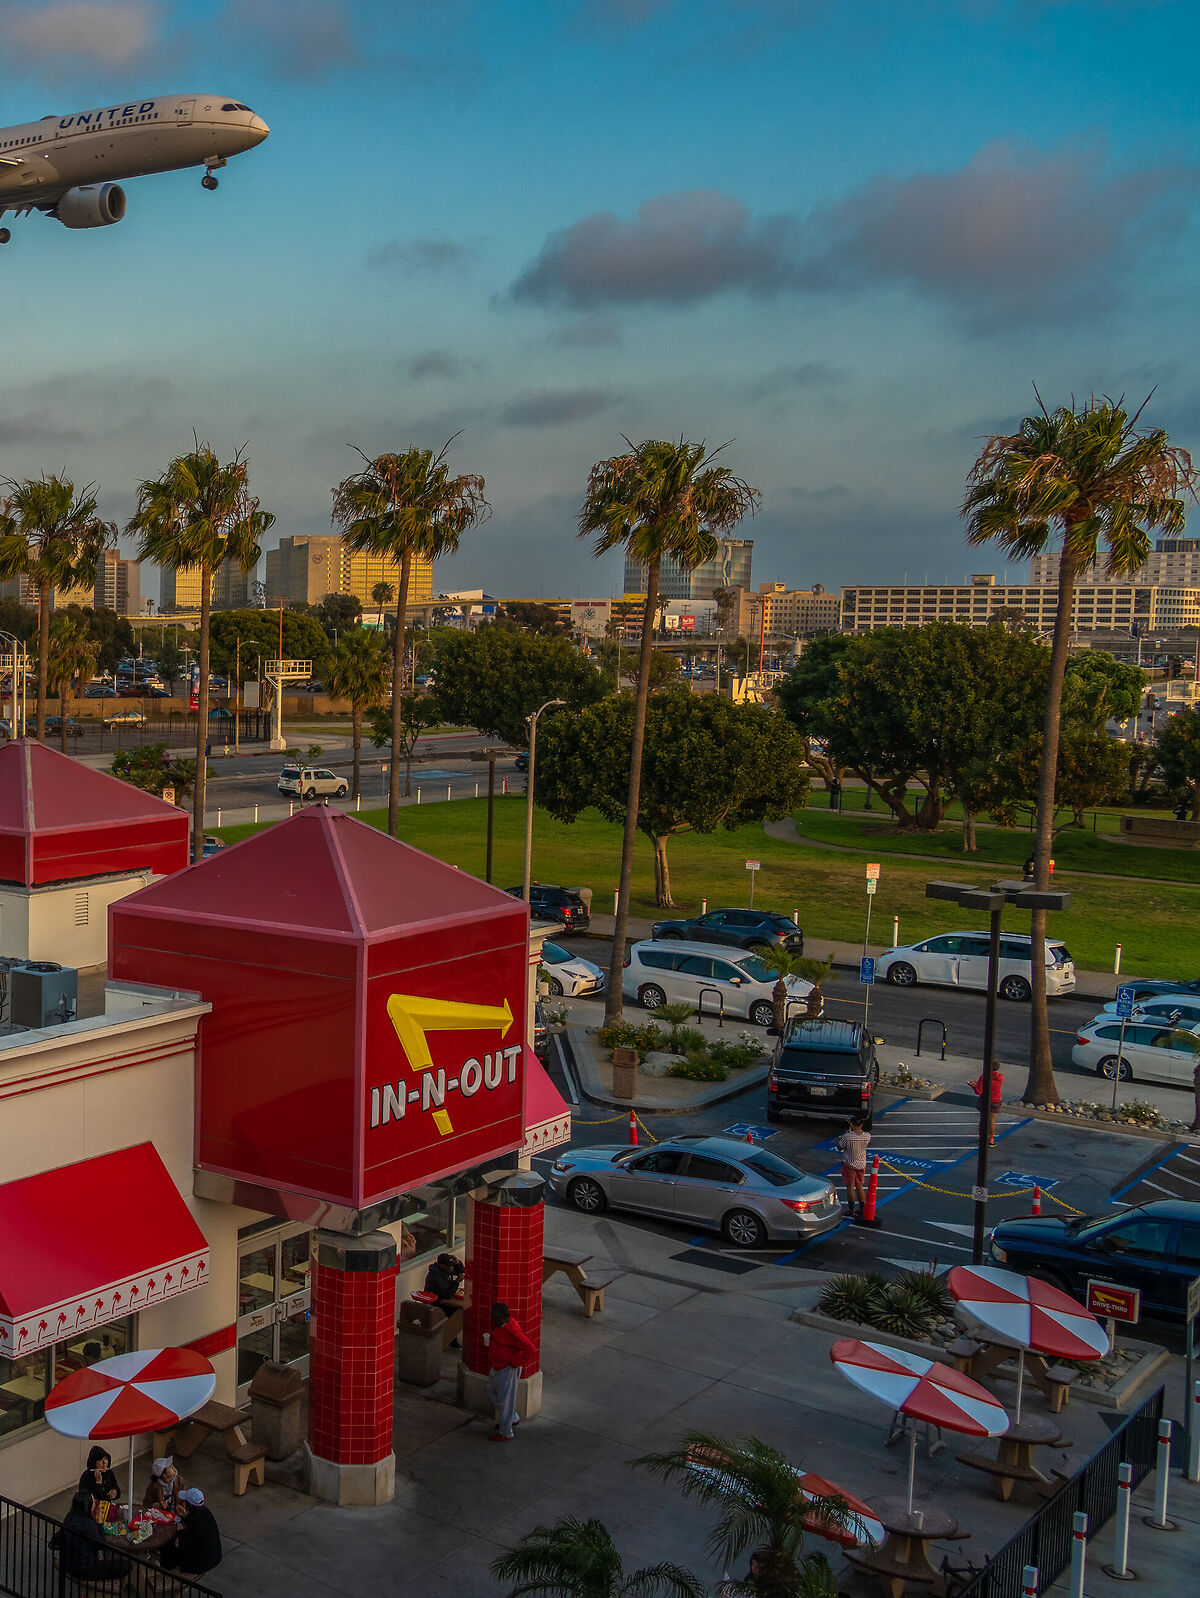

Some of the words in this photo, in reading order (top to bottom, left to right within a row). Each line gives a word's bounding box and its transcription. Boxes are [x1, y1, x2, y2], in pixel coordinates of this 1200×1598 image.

[59, 102, 155, 129] UNITED
[370, 1043, 522, 1130] IN-N-OUT
[1092, 1300, 1128, 1313] DRIVE-THRU
